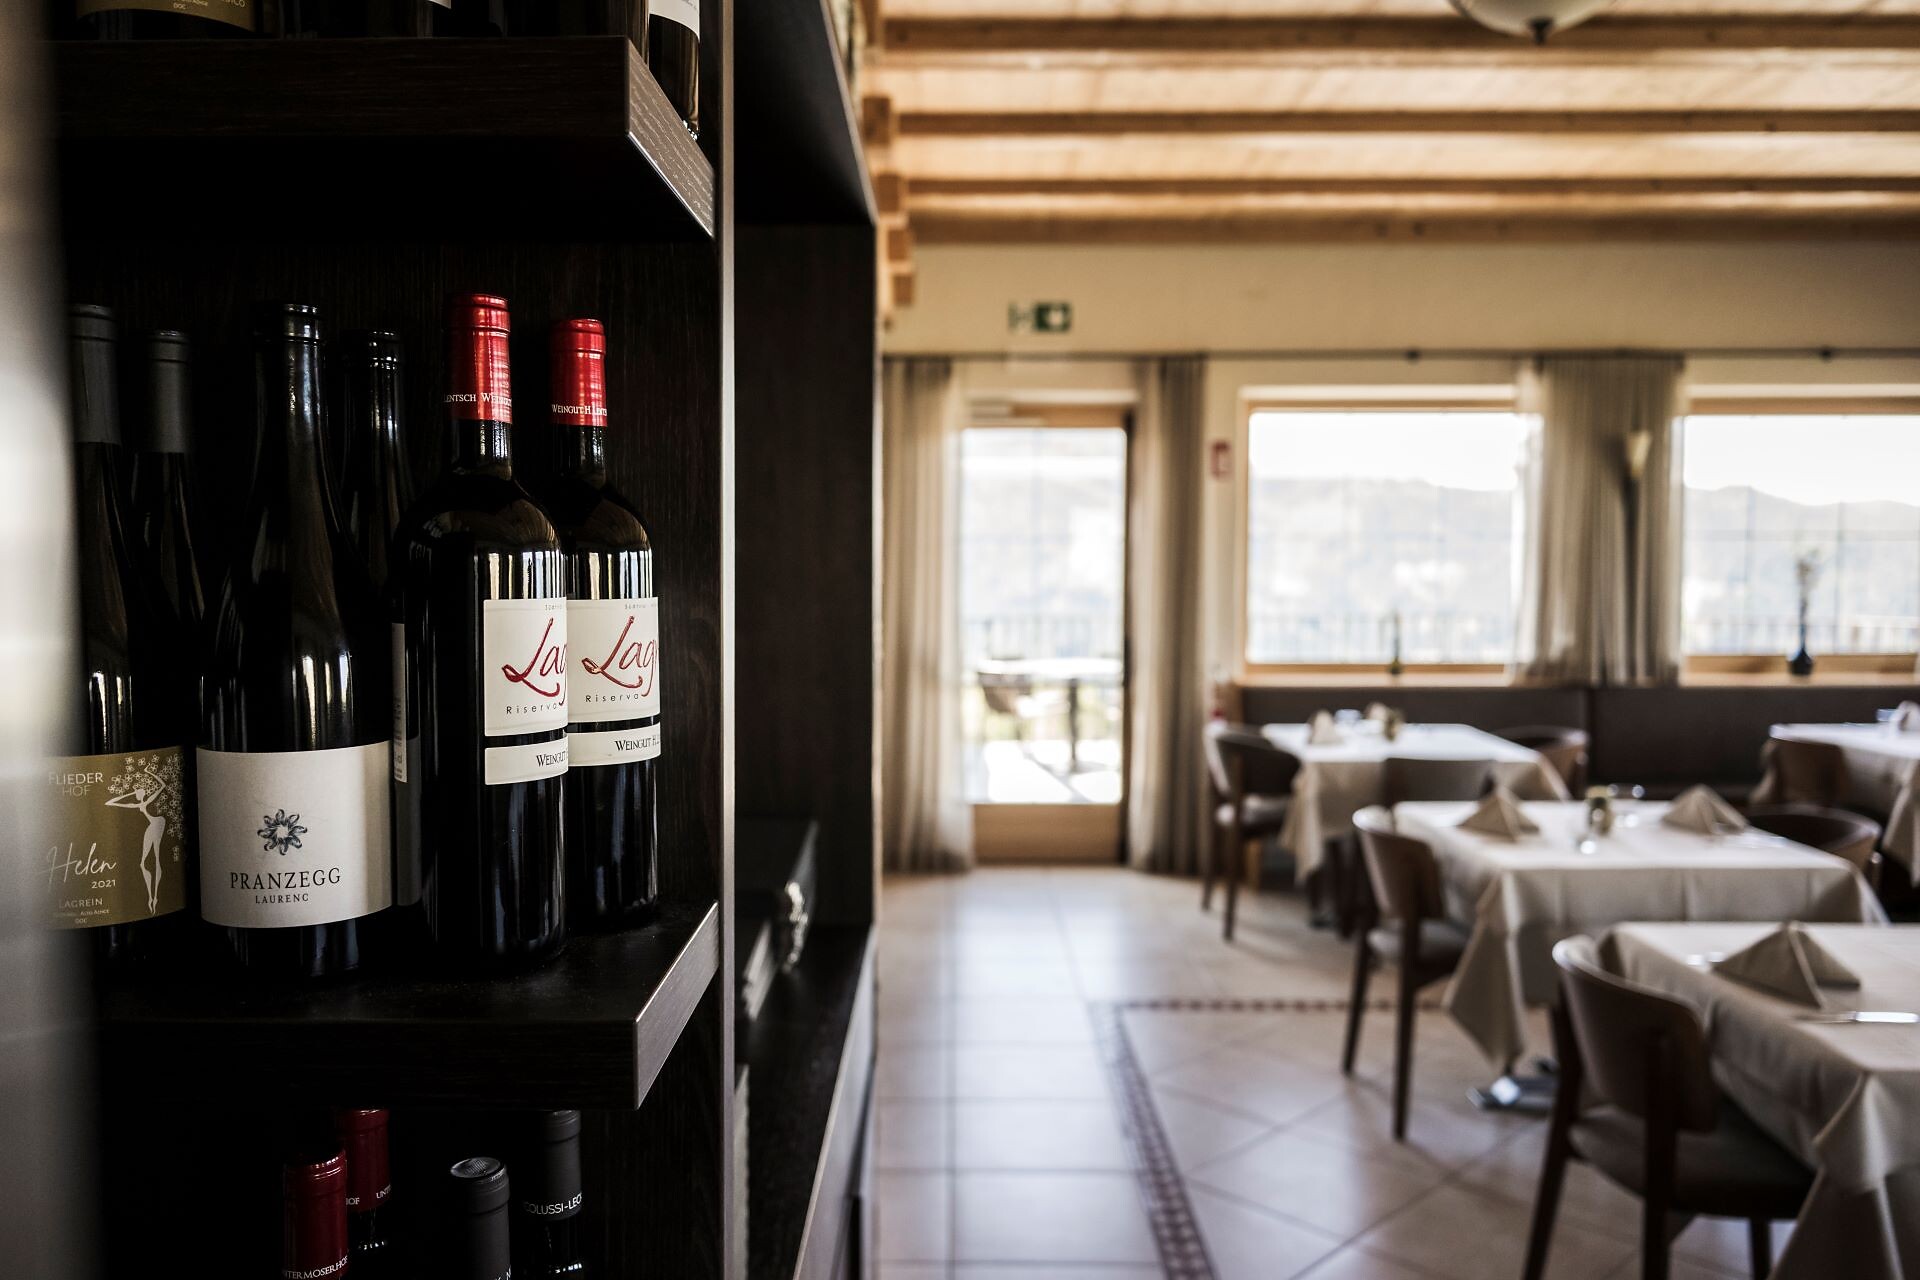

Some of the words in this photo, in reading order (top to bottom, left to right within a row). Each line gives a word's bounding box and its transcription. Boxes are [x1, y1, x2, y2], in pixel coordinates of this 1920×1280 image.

[585, 692, 639, 703] Riserva
[506, 702, 558, 715] Riserva
[48, 772, 104, 785] FLIEDER
[62, 784, 92, 796] HOF
[47, 841, 117, 889] Helen
[91, 879, 117, 889] 2021
[230, 867, 341, 889] PRANZEGG
[58, 897, 103, 909] LAGREIN
[255, 893, 310, 904] LAURENC
